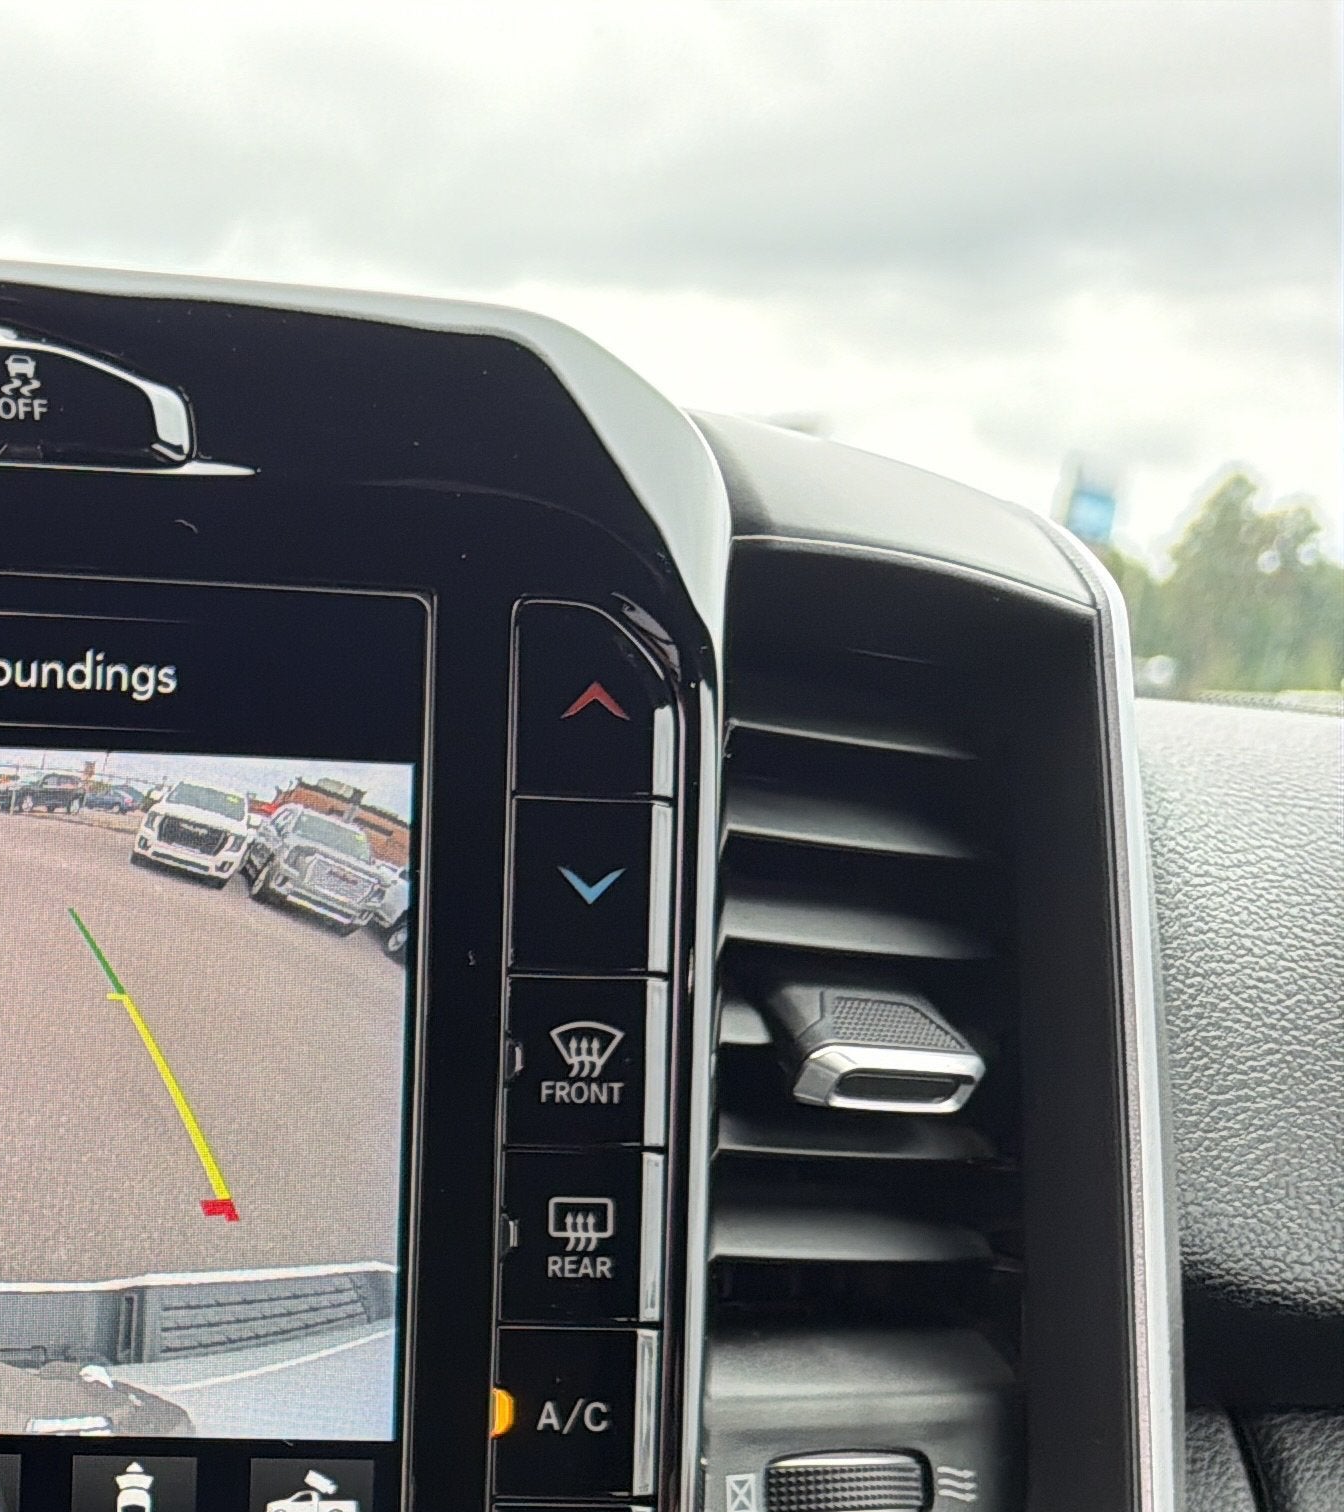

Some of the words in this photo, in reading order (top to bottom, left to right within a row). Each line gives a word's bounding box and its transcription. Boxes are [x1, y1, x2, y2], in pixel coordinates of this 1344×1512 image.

[540, 1080, 625, 1105] FRONT
[547, 1255, 613, 1279] REAR
[536, 1398, 609, 1435] A/C
